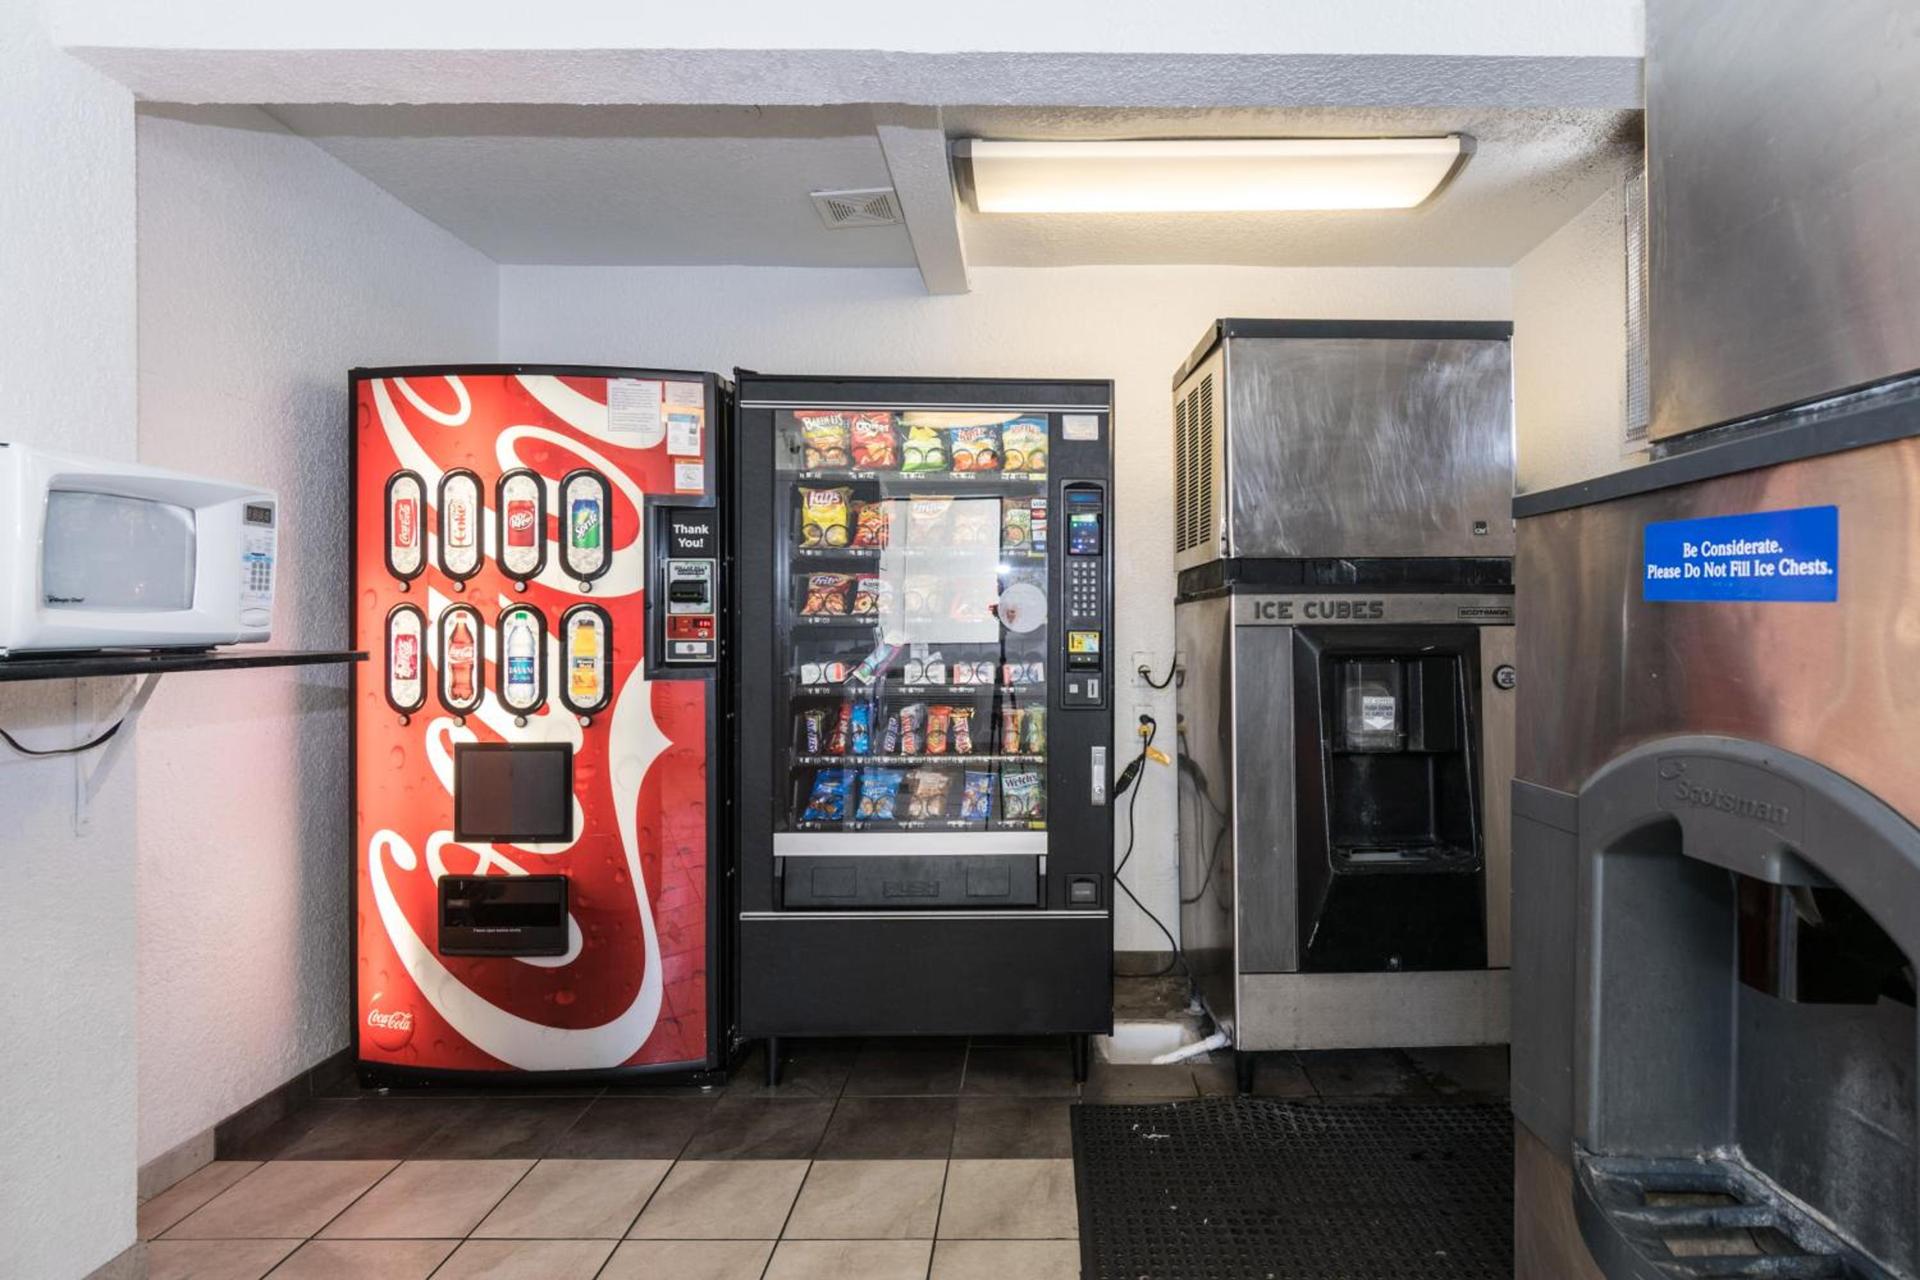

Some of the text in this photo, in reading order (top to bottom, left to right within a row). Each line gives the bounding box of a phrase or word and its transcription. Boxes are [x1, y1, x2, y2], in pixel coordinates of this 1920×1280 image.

[673, 524, 709, 535] Thank
[678, 538, 704, 548] You!
[1682, 539, 1783, 558] Be Considerate.
[1647, 558, 1833, 579] Please Do Not Fill Ice Chests.
[1254, 601, 1384, 619] ICE CUBES
[1673, 780, 1790, 824] Scotsman
